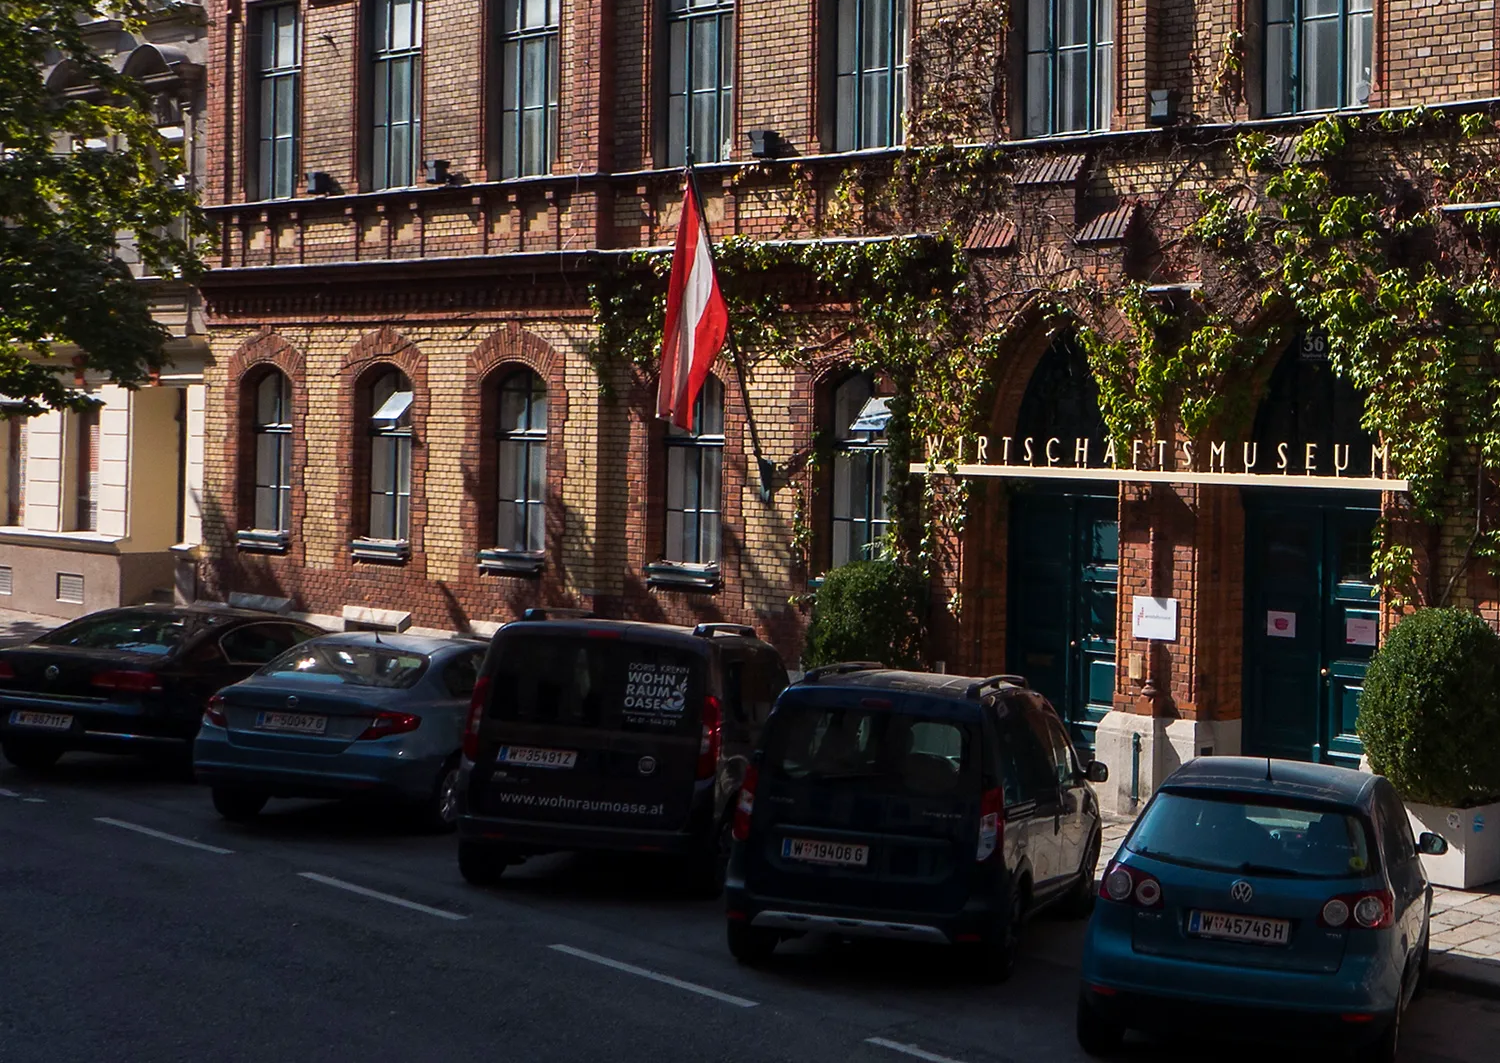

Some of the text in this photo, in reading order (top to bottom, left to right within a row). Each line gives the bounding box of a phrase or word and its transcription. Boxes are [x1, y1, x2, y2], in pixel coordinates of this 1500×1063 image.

[1303, 336, 1325, 352] 36
[926, 435, 1390, 472] WIRTSCHAFTSMUSEUM
[628, 672, 676, 686] WOHN
[626, 684, 671, 698] RAUM
[624, 696, 662, 710] OASE
[509, 748, 518, 760] W
[500, 791, 664, 815] www.wohnraumoase.at
[794, 842, 804, 855] W
[1203, 915, 1213, 931] W
